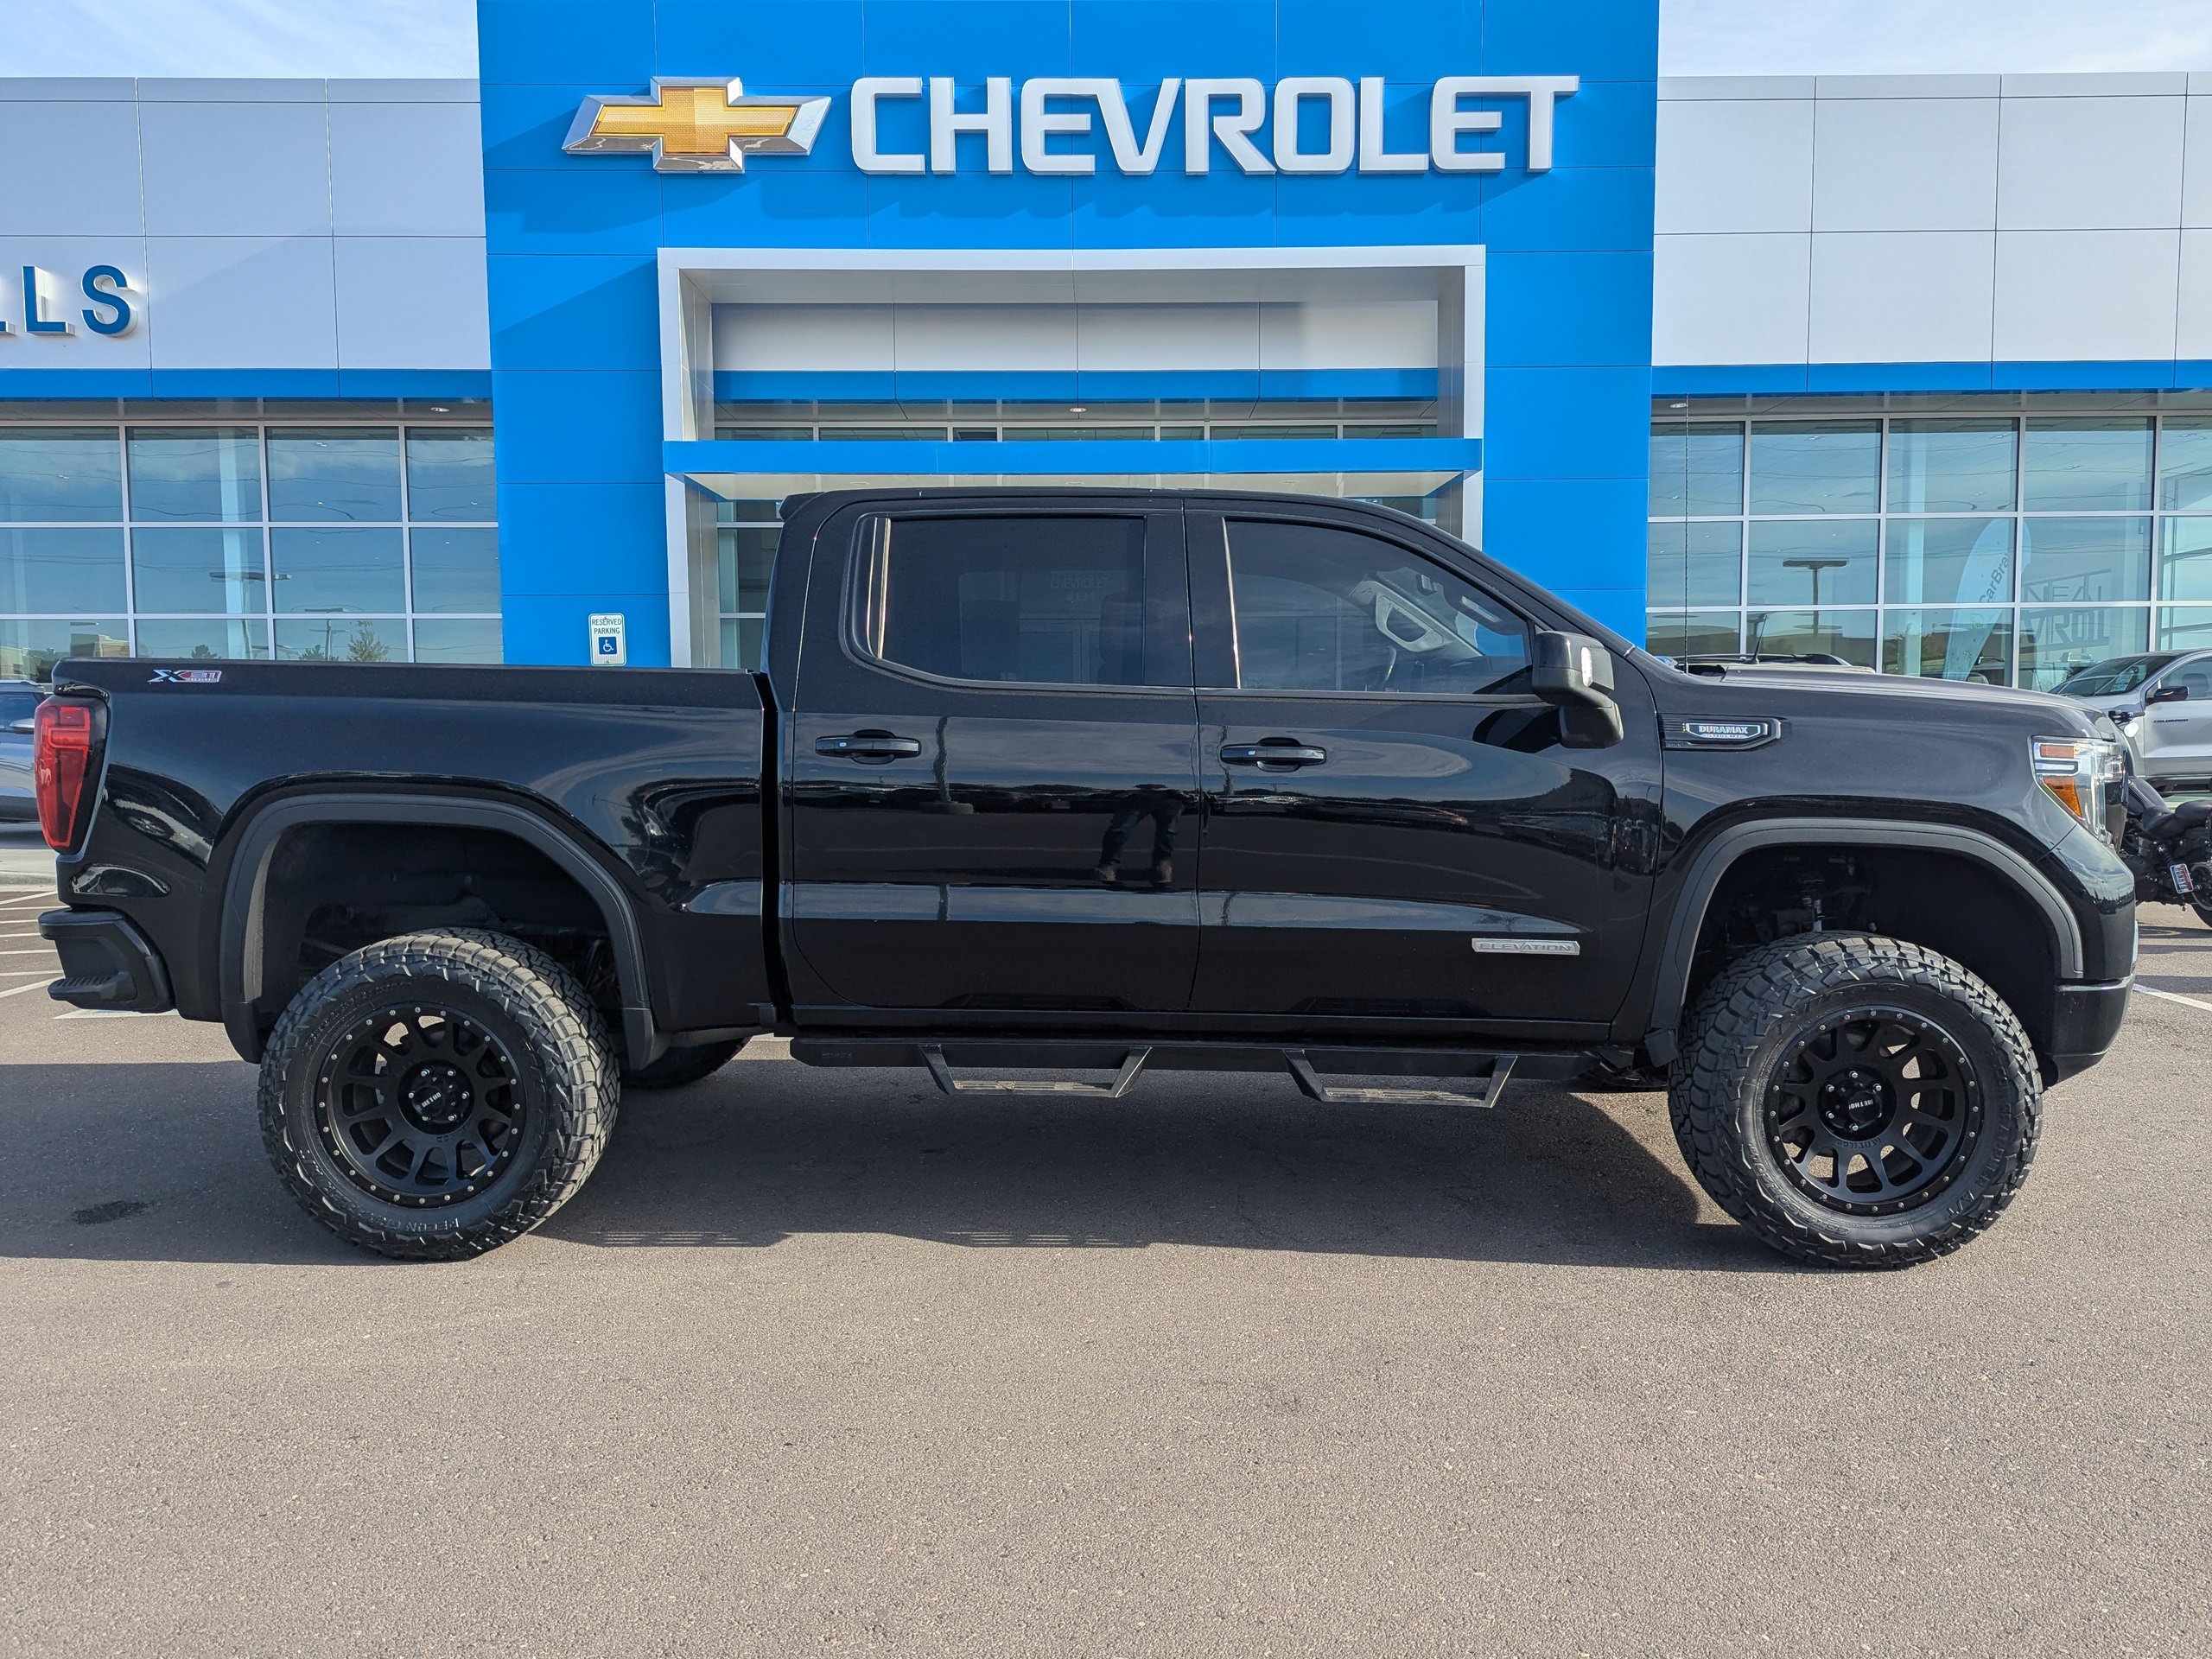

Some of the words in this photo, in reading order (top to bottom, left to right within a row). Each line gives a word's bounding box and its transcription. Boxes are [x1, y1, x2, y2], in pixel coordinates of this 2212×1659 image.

[851, 75, 1579, 175] CHEVROLET
[0, 264, 132, 334] LS
[1698, 725, 1749, 734] DURAMAX
[1479, 943, 1572, 951] ELEVATION
